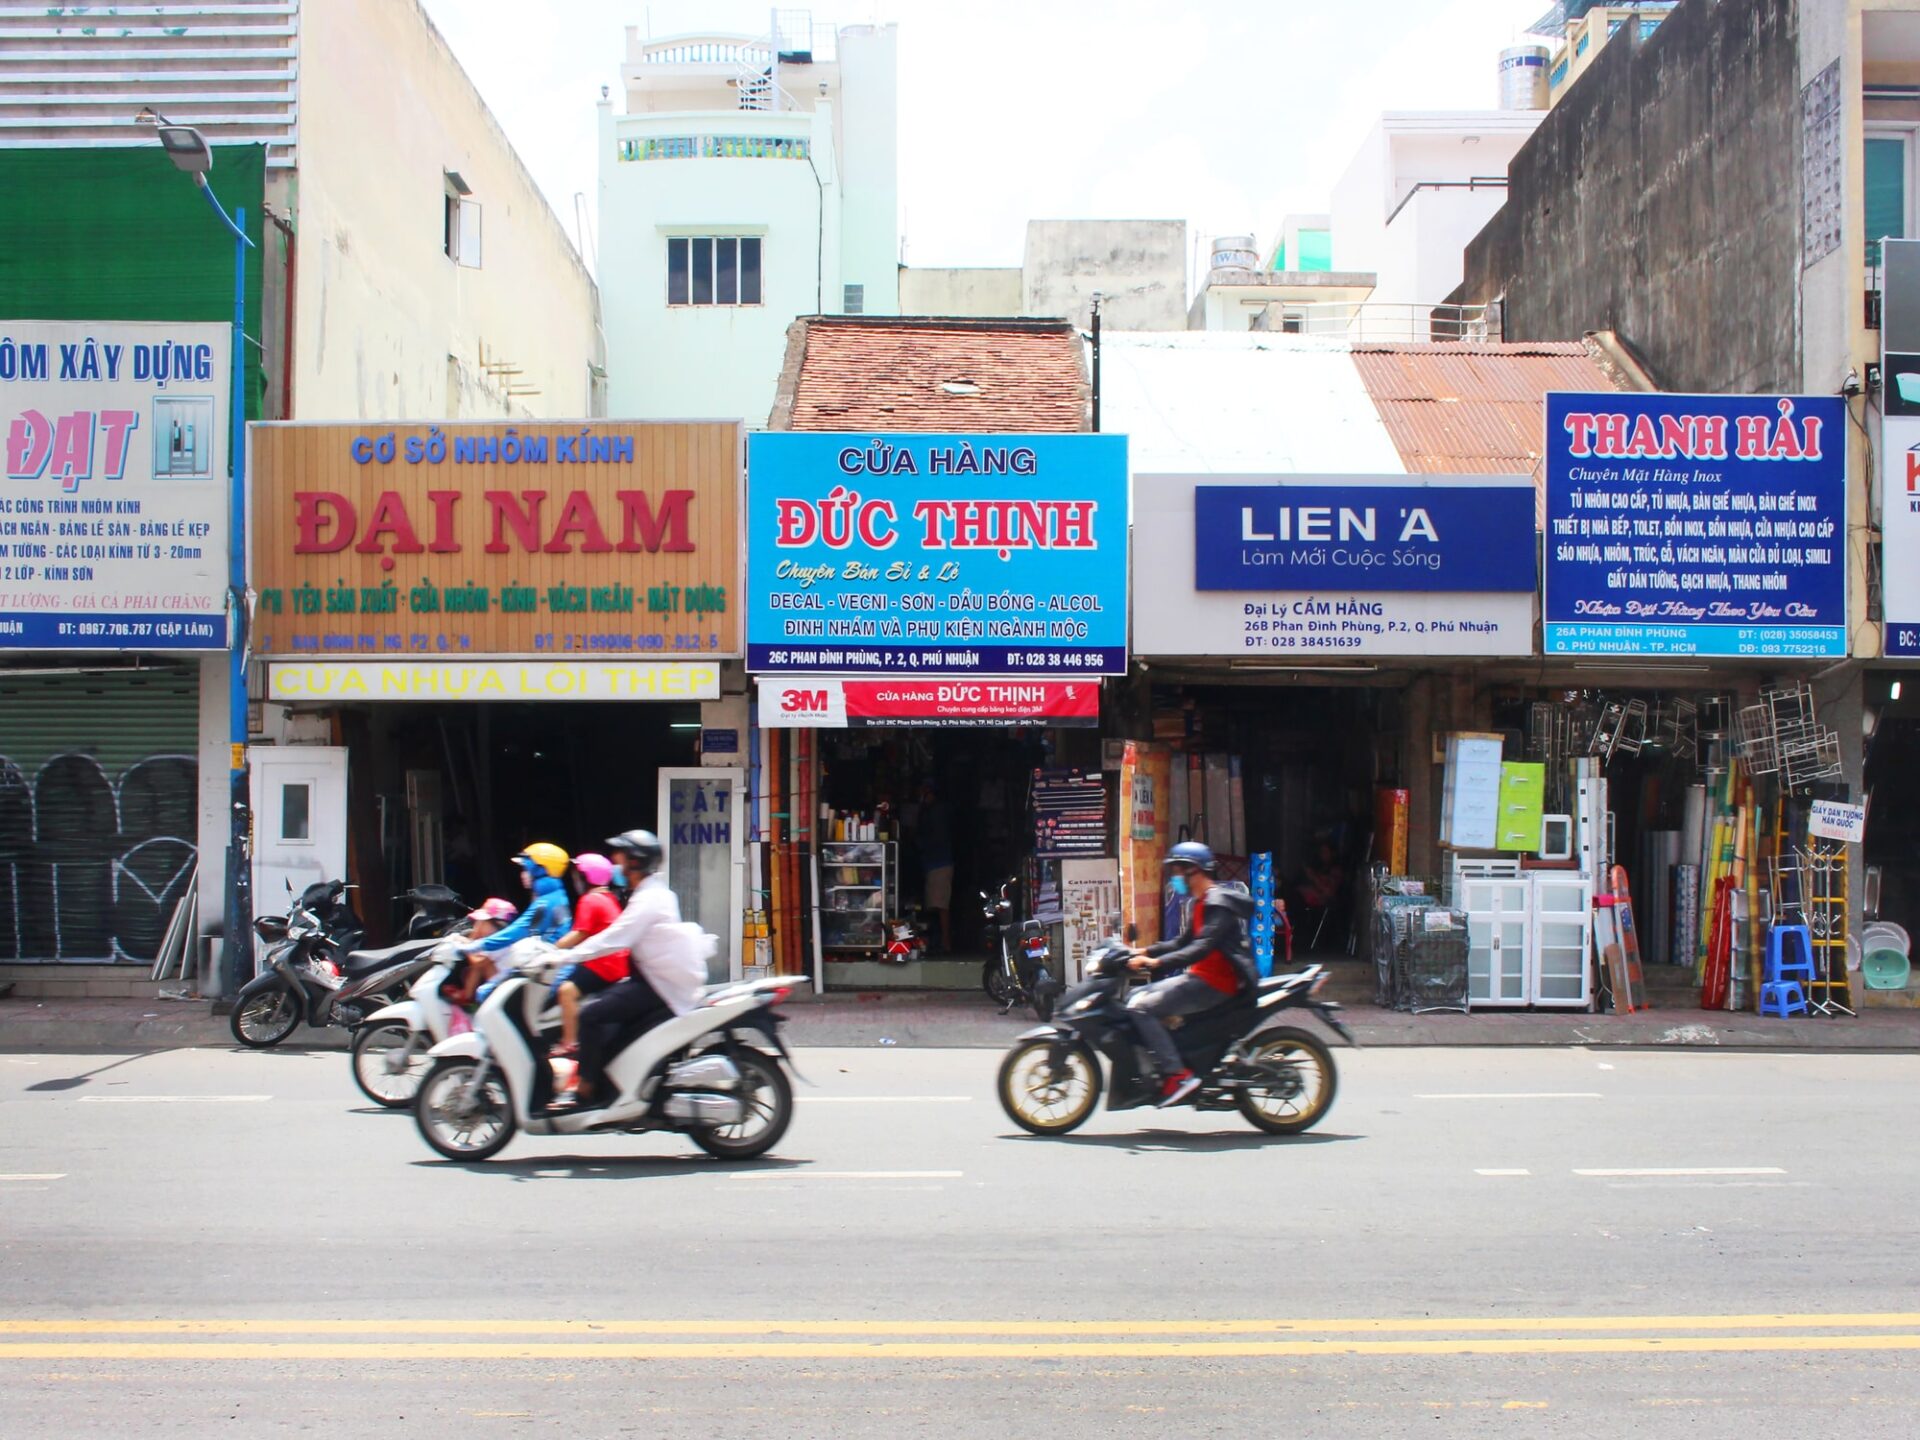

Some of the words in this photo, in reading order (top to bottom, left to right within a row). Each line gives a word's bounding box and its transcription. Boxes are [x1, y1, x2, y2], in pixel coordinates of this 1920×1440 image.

[59, 337, 122, 381] XÂY
[133, 339, 212, 388] DỰNG
[1563, 412, 1728, 460] THANH
[1735, 398, 1823, 461] HẢI
[6, 409, 138, 492] ĐẠT
[351, 432, 395, 464] CƠ
[404, 425, 446, 464] SỞ
[454, 428, 548, 464] NHÔM
[556, 428, 634, 463] KÍNH
[838, 439, 918, 475] CỬA
[928, 440, 1037, 475] HÀNG
[1568, 467, 1619, 484] Chuyên
[1622, 468, 1650, 484] Mặt
[1653, 469, 1689, 485] Hàng
[1692, 470, 1722, 482] Inox
[16, 498, 44, 514] CÔNG
[48, 498, 78, 514] TRÌNH
[82, 498, 112, 514] NHÔM
[117, 498, 141, 514] KÍNH
[1570, 487, 1582, 508] TỦ
[1584, 489, 1610, 508] NHÔM
[1611, 493, 1628, 509] CAO
[1630, 488, 1650, 512] CẤP,
[1651, 488, 1663, 509] TỦ
[1665, 492, 1691, 513] NHỰA,
[1693, 490, 1711, 511] BÀN
[1712, 489, 1730, 511] GHẾ
[1732, 492, 1758, 514] NHỰA,
[1759, 491, 1777, 511] BÀN
[1778, 490, 1797, 511] GHẾ
[1797, 496, 1817, 511] INOX
[189, 523, 210, 539] KẸP
[293, 490, 462, 571] ĐẠI
[484, 490, 696, 553] NAM
[775, 485, 900, 549] ĐỨC
[913, 499, 1098, 561] THỊNH
[56, 543, 77, 558] CÁC
[82, 545, 105, 561] LOẠI
[109, 543, 133, 558] KÍNH
[154, 545, 160, 558] 3
[171, 545, 201, 558] 20mm
[1242, 548, 1284, 566] Làm
[1290, 546, 1326, 566] Mới
[1332, 548, 1386, 571] Cuộc
[1392, 546, 1441, 571] Sống
[5, 566, 11, 579] 2
[45, 565, 68, 580] KÍNH
[776, 559, 836, 588] Chuyên
[841, 561, 879, 581] Bán
[360, 578, 398, 613] XUẤT
[410, 577, 439, 613] CỬA
[444, 579, 488, 613] NHÔM
[501, 579, 537, 613] KÍNH
[548, 580, 587, 613] VÁCH
[770, 592, 824, 610] DECAL
[838, 593, 888, 611] VECNI
[901, 592, 936, 611] SƠN
[988, 590, 1034, 611] BÓNG
[1048, 595, 1103, 612] ALCOL
[1244, 603, 1267, 618] Đại
[1271, 603, 1287, 618] Lý
[1335, 597, 1383, 616] HẰNG
[79, 622, 152, 636] 0967.706.787
[155, 621, 181, 637] (GẶP
[185, 621, 213, 637] LÂM)
[784, 619, 824, 636] ĐINH
[828, 616, 876, 637] NHÁM
[880, 616, 902, 637] VÀ
[906, 620, 940, 640] PHỤ
[945, 617, 984, 640] KIỆN
[988, 616, 1046, 638] NGÀNH
[1050, 618, 1088, 641] MỘC
[1244, 621, 1269, 632] 26B
[1272, 621, 1303, 632] Phan
[1308, 620, 1337, 632] Đình
[1342, 620, 1385, 634] Phùng,
[1415, 621, 1428, 633] Q.
[1431, 620, 1455, 632] Phú
[1459, 620, 1498, 635] Nhuận
[1556, 627, 1577, 637] 26A
[1580, 627, 1613, 637] PHAN
[1615, 626, 1643, 637] ĐÌNH
[1738, 630, 1757, 640] ĐT:
[1760, 630, 1787, 641] (028)
[1789, 630, 1839, 640] 35058453
[1245, 637, 1268, 647] ĐT:
[1271, 637, 1296, 647] 028
[1301, 637, 1362, 647] 38451639
[1556, 641, 1568, 651] Q.
[1572, 640, 1596, 651] PHÚ
[1650, 643, 1668, 652] TP.
[1671, 643, 1697, 653] HCM
[1738, 644, 1759, 654] DĐ:
[1761, 644, 1781, 654] 093
[1783, 644, 1827, 654] 7752216
[769, 651, 788, 664] 26C
[790, 651, 817, 665] PHAN
[819, 649, 843, 665] ĐÌNH
[846, 649, 882, 667] PHÙNG,
[885, 652, 895, 665] P.
[897, 652, 907, 667] 2,
[909, 652, 919, 667] Q.
[922, 650, 942, 665] PHÚ
[945, 650, 979, 667] NHUẬN
[1007, 653, 1024, 666] ĐT:
[1026, 653, 1045, 666] 028
[1047, 653, 1061, 666] 38
[1063, 653, 1082, 667] 446
[1084, 653, 1104, 667] 956
[274, 663, 369, 694] CỬA
[382, 668, 506, 699] NHỰA
[603, 662, 715, 694] THÉP
[780, 689, 828, 712] 3M
[876, 689, 899, 702] CỬA
[902, 689, 934, 702] HÀNG
[937, 682, 981, 702] ĐỨC
[987, 686, 1045, 705] THỊNH
